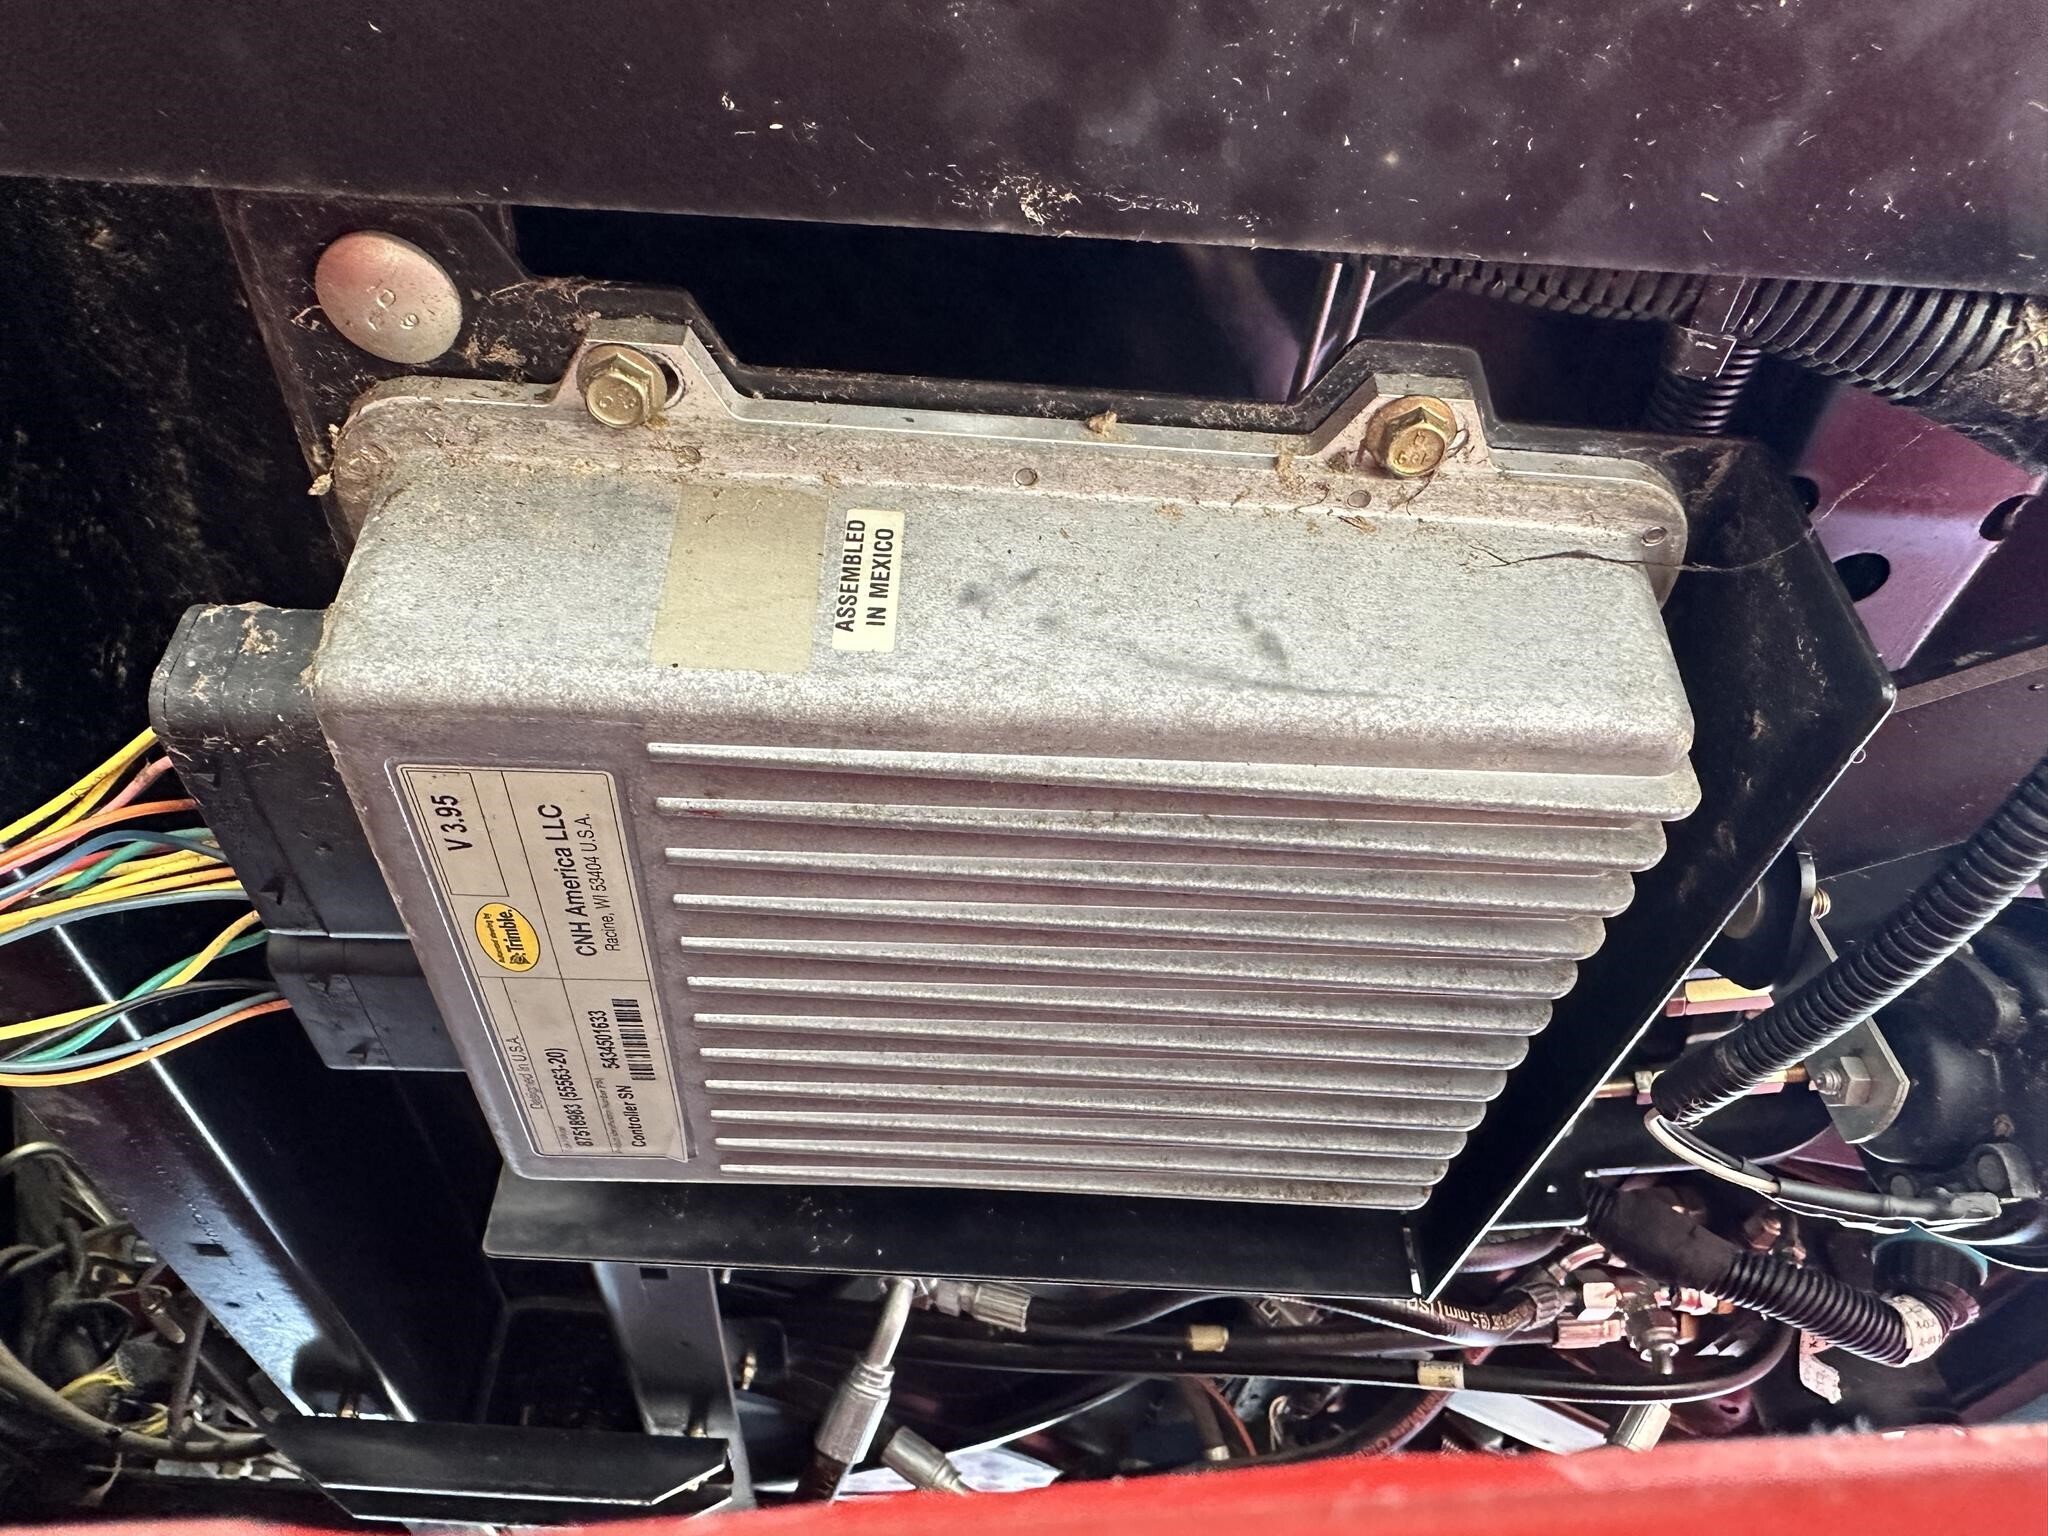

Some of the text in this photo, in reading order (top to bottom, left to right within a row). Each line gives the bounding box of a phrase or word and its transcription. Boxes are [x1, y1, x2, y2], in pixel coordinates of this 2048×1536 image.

[835, 519, 866, 633] ASSEMBLED
[866, 528, 894, 626] IN MEXICO
[431, 795, 473, 851] V 3.95
[537, 804, 597, 957] CNH America LLC
[574, 813, 621, 952] Racine, WI 53404 U.S.A.
[588, 1010, 620, 1069] 5434501633
[523, 1073, 544, 1110] Designed
[544, 1048, 583, 1101] (55563-20)
[563, 1103, 593, 1148] 87518983
[615, 1084, 647, 1148] Controller SN
